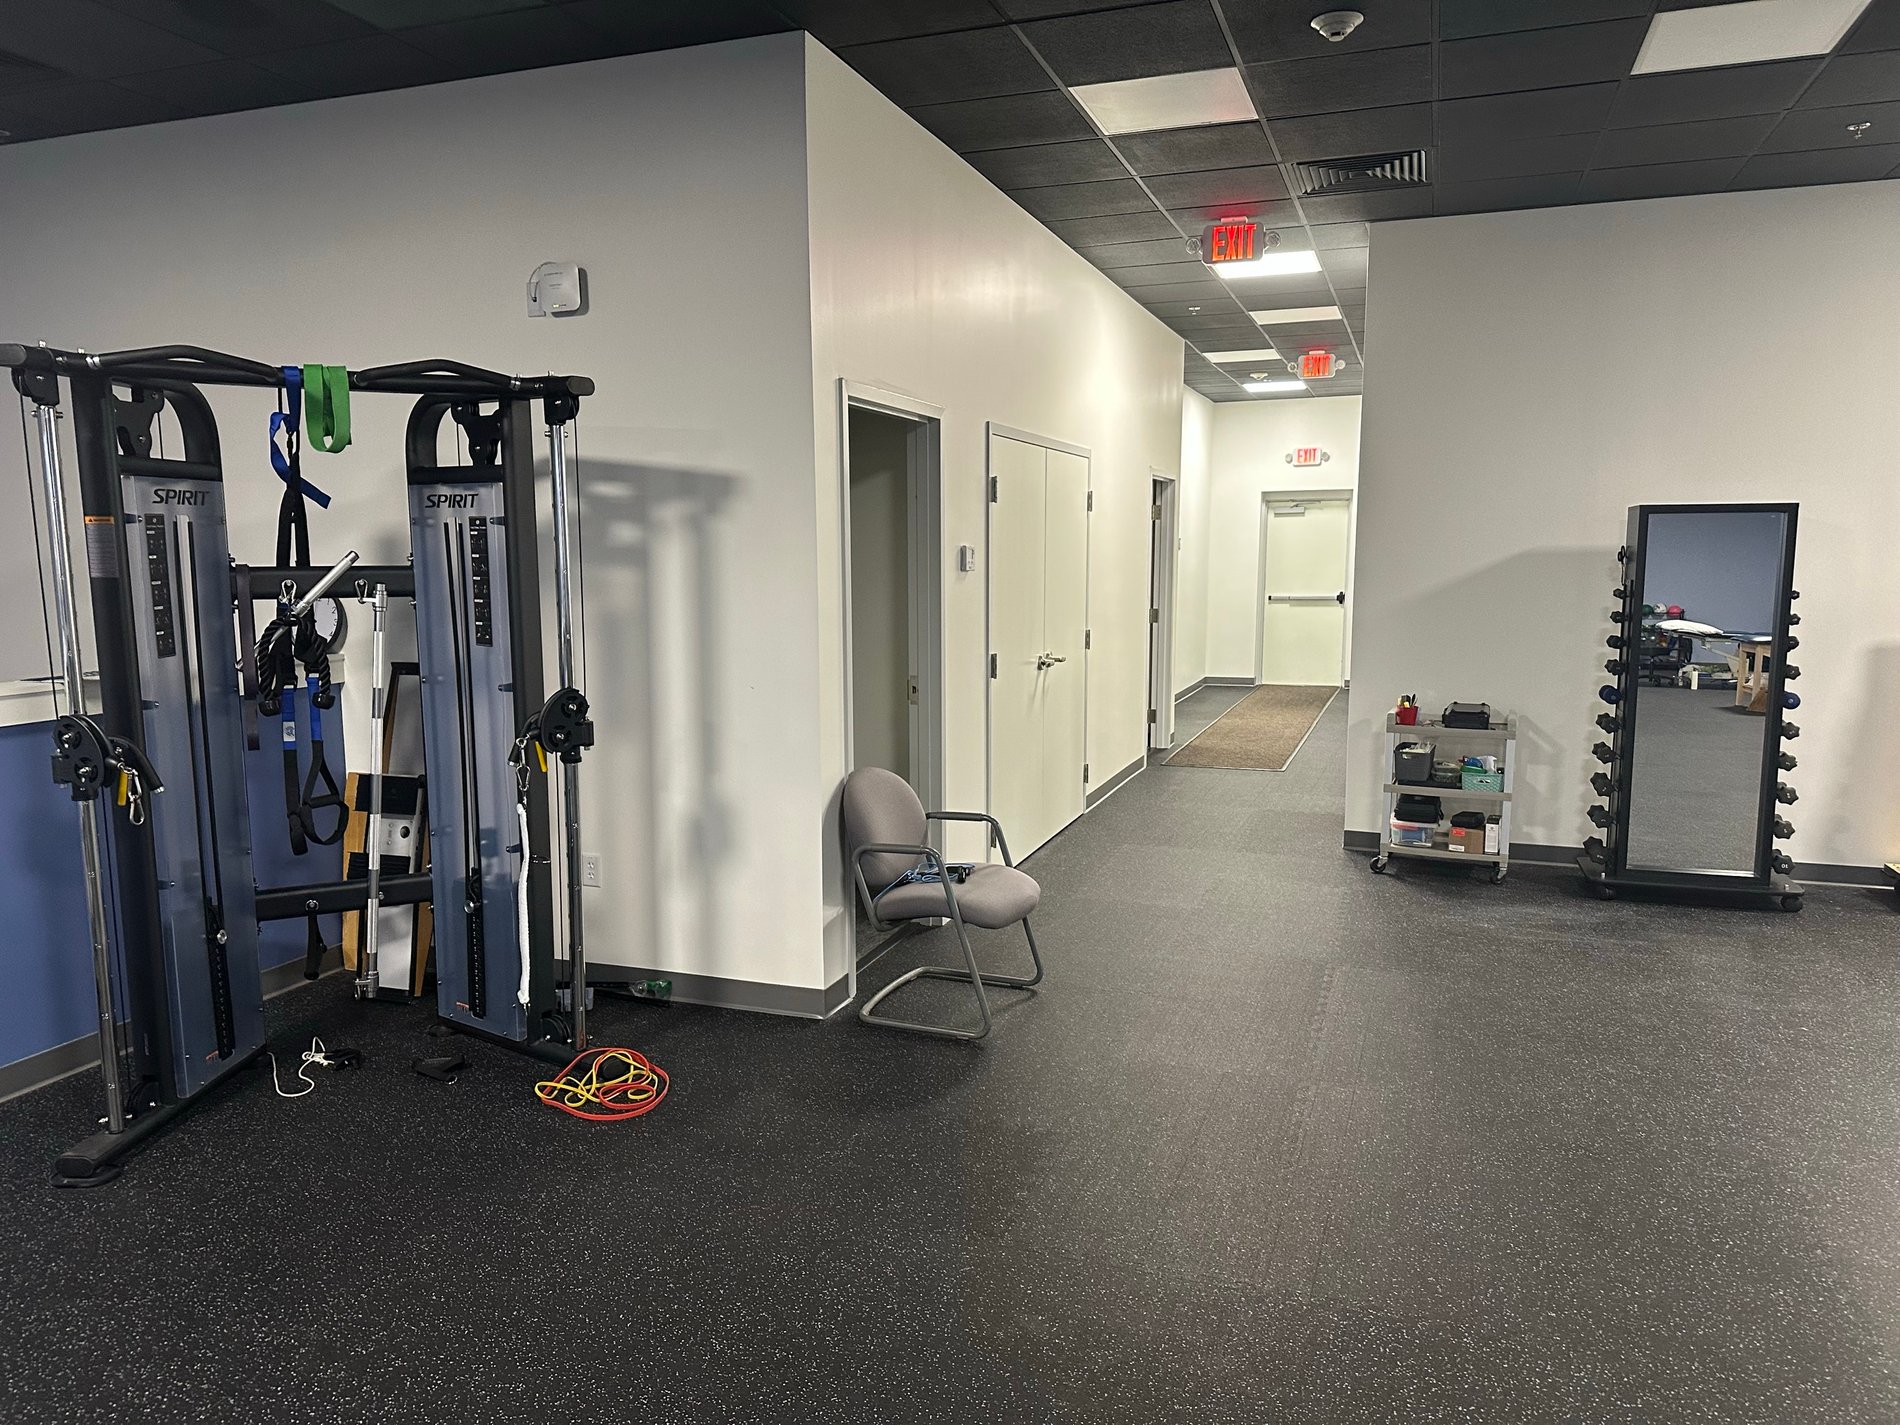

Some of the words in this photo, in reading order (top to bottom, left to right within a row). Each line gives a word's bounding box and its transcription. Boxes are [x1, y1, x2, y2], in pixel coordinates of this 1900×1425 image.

[1212, 224, 1257, 261] EXIT
[1303, 353, 1330, 376] EXIT
[1297, 448, 1317, 463] EXIT
[152, 488, 210, 506] SPIRIT
[425, 493, 479, 508] SPIRIT
